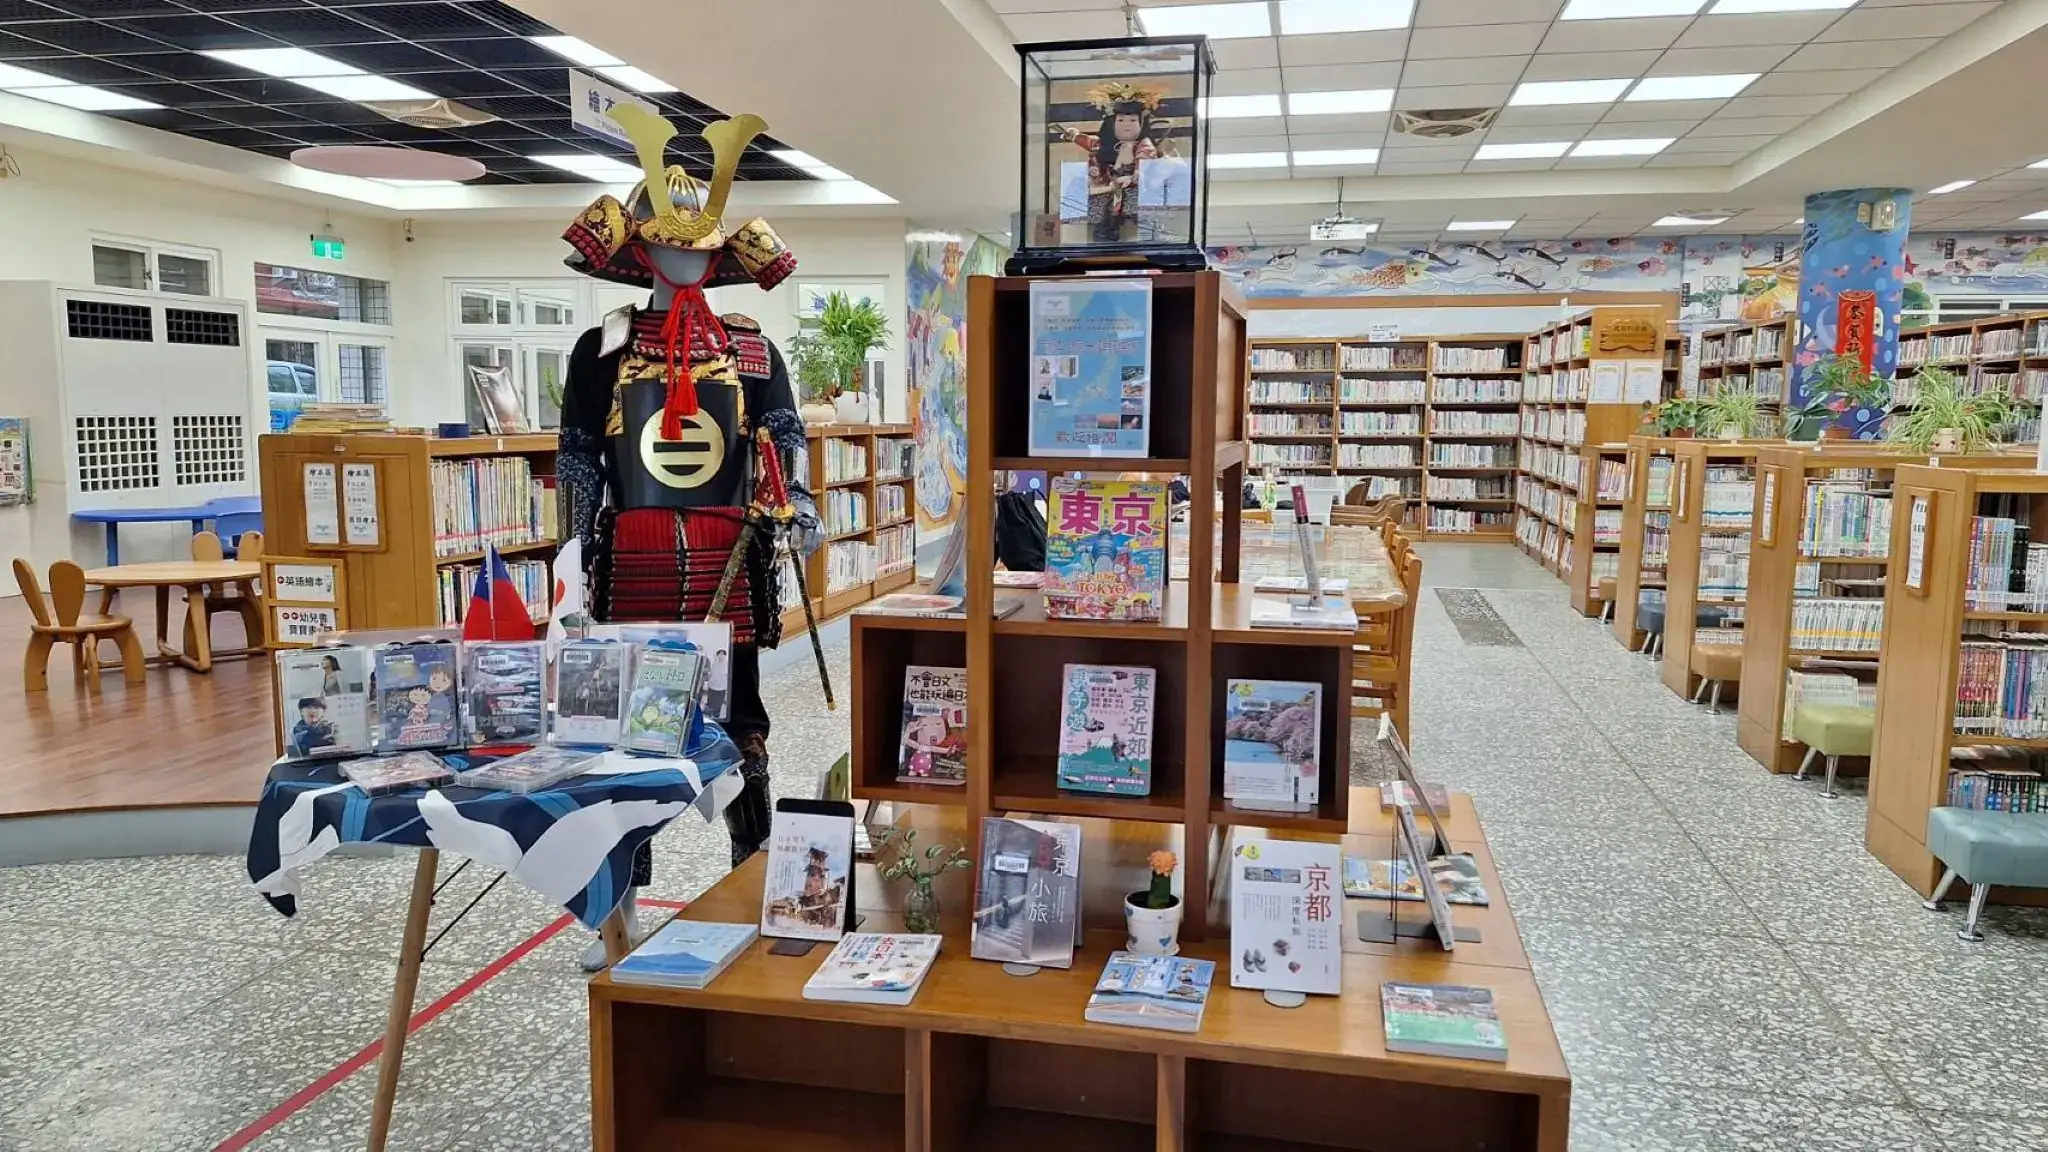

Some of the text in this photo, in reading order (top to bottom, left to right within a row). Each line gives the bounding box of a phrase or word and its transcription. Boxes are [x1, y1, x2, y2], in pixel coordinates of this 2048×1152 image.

[1060, 489, 1156, 535] 東京
[285, 576, 323, 587] 英語繪本
[1078, 583, 1128, 596] TOKYO
[911, 671, 951, 687] 不會日文
[911, 689, 967, 702] 也能玩遍日
[1128, 672, 1151, 757] 東京近郊
[1029, 878, 1051, 924] 小旅
[1304, 863, 1332, 922] 京都
